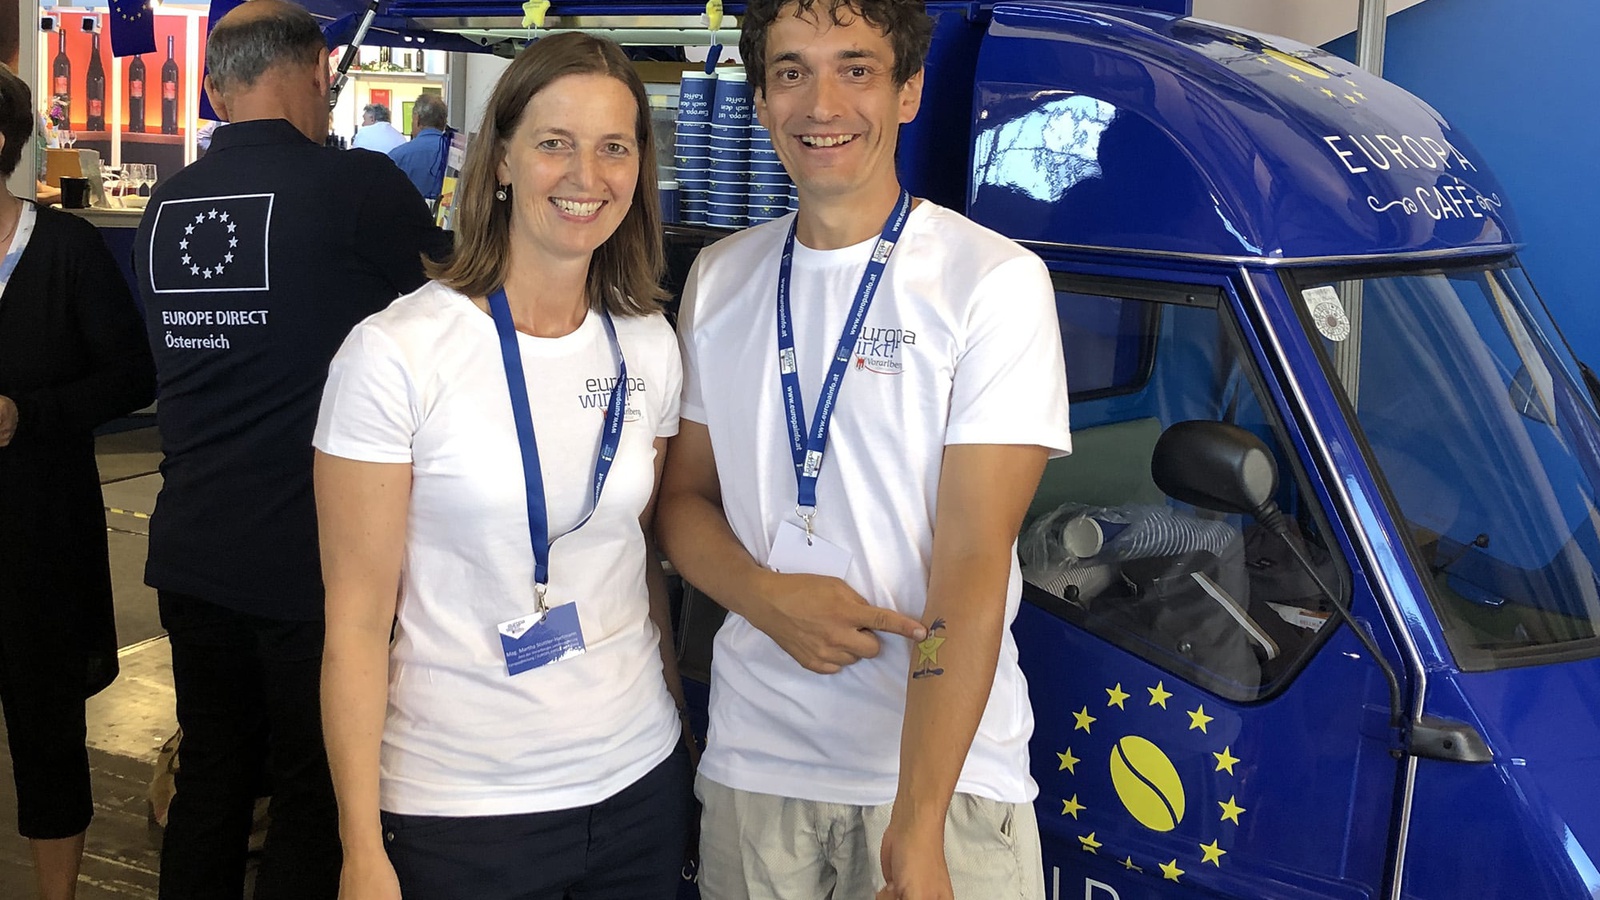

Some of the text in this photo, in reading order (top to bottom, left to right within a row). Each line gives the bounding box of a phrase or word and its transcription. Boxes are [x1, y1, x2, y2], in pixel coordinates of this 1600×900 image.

[686, 108, 709, 116] Europa
[1323, 134, 1478, 174] EUROPA
[1415, 177, 1483, 220] CAFÉ
[779, 277, 789, 338] www.europainfo.at
[849, 273, 877, 336] www.europainfo.at
[162, 310, 269, 326] EUROPE DIRECT
[165, 331, 230, 349] Österreich
[856, 337, 896, 359] irkt!
[862, 326, 917, 349] uropa
[867, 357, 903, 371] Vorarlber
[585, 377, 647, 397] eurpa
[816, 373, 840, 439] www.europainfo.at
[786, 385, 804, 451] www.europainfo.at
